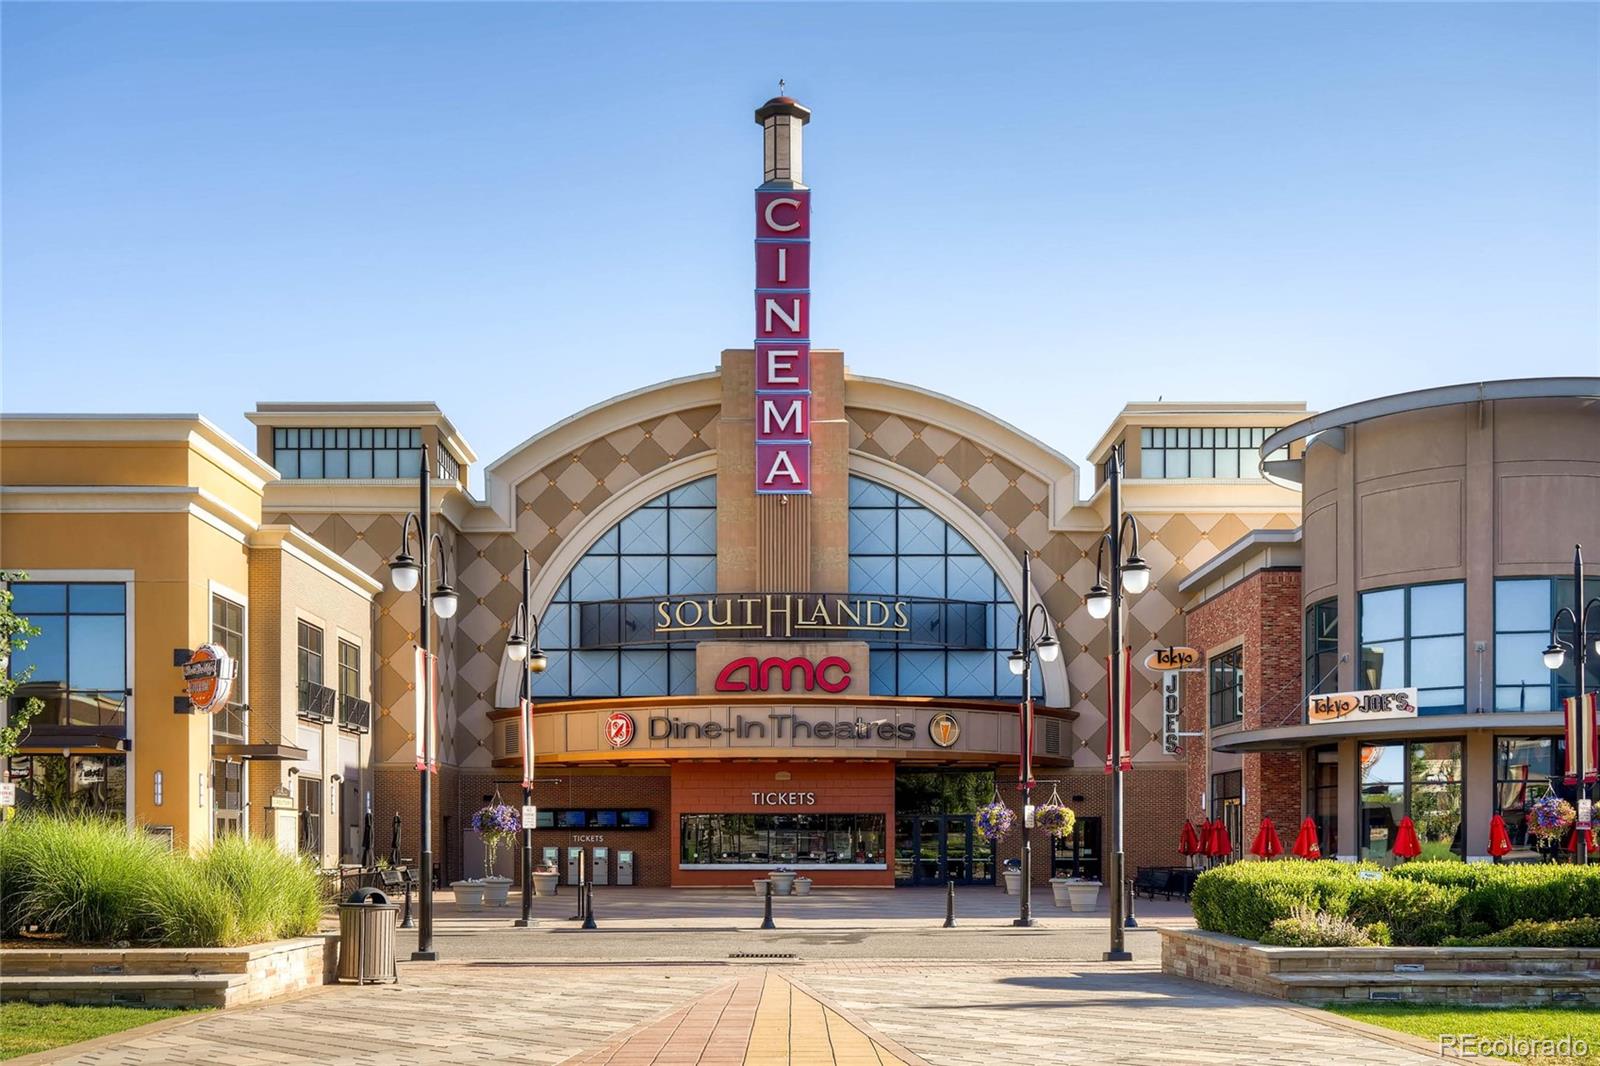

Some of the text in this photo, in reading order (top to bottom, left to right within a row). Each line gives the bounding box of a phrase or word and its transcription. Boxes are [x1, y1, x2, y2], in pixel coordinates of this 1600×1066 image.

[763, 197, 803, 485] CINEMA
[657, 595, 909, 637] SOUTHLANDS
[1153, 646, 1193, 669] Tokyo
[1165, 674, 1180, 753] JOE'S
[1311, 692, 1409, 718] Tokyo JOE'S
[648, 713, 916, 741] Dine-In Theatres
[751, 791, 816, 806] TICKETS
[573, 834, 604, 843] TICKETS
